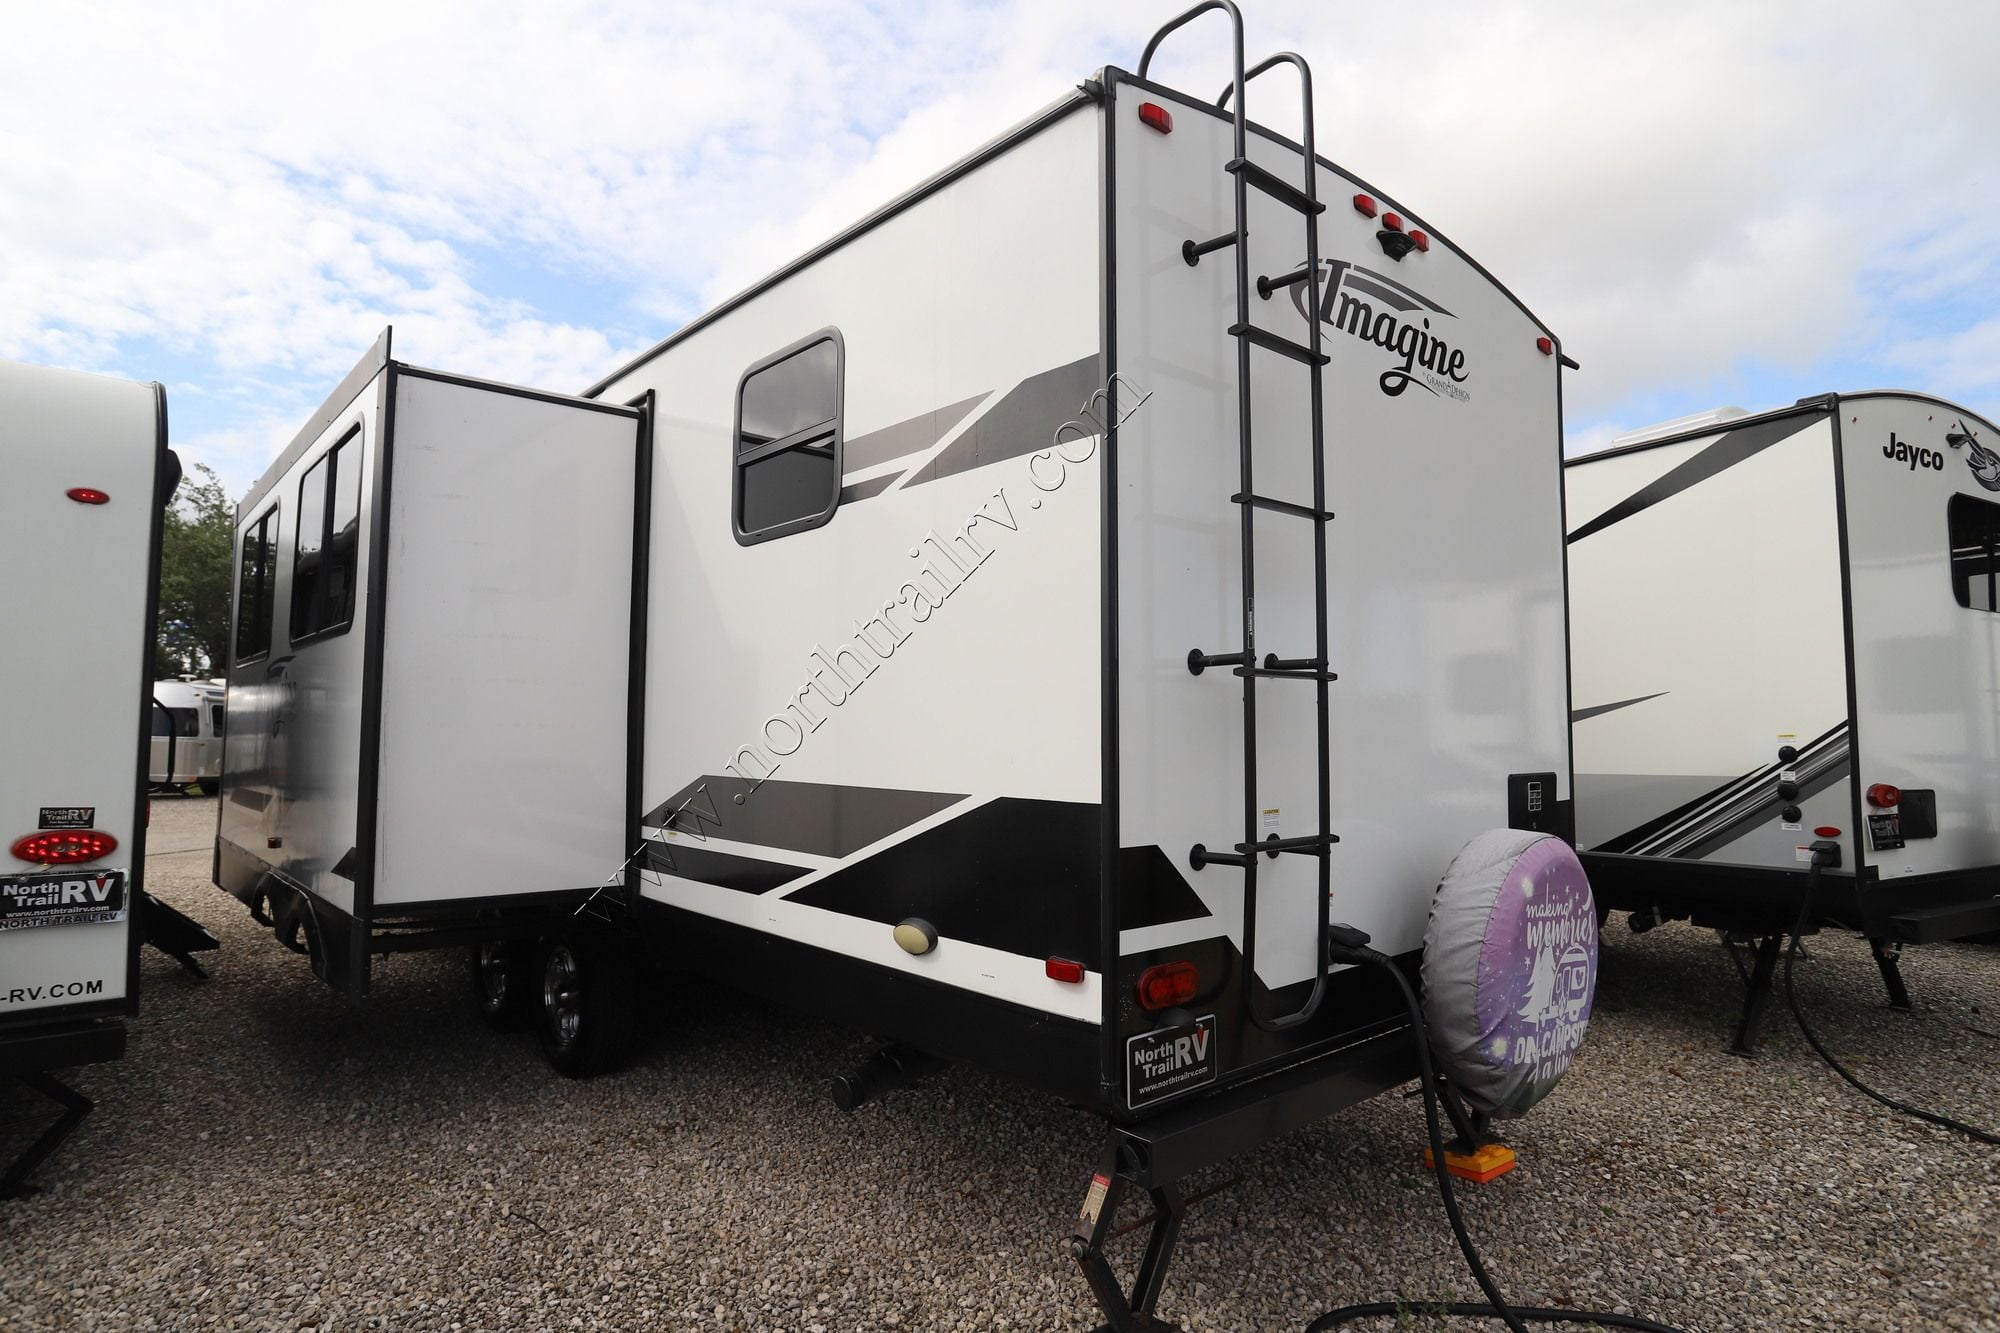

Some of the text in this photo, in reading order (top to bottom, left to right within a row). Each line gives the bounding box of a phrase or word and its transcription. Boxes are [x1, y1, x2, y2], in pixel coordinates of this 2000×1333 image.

[1319, 258, 1470, 397] Imagine
[1883, 432, 1944, 471] Jayco
[67, 808, 93, 821] RV
[3, 882, 60, 896] North
[13, 893, 59, 907] Trail
[62, 878, 115, 904] RV
[6, 905, 109, 918] www.northtrailrv.com
[1526, 883, 1573, 920] making
[0, 911, 118, 929] NORTH TRAIL RV
[1135, 1042, 1173, 1066] North
[1175, 1029, 1210, 1069] RV
[1143, 1056, 1174, 1079] Trail
[1139, 1066, 1208, 1094] www.northtrailrv.com
